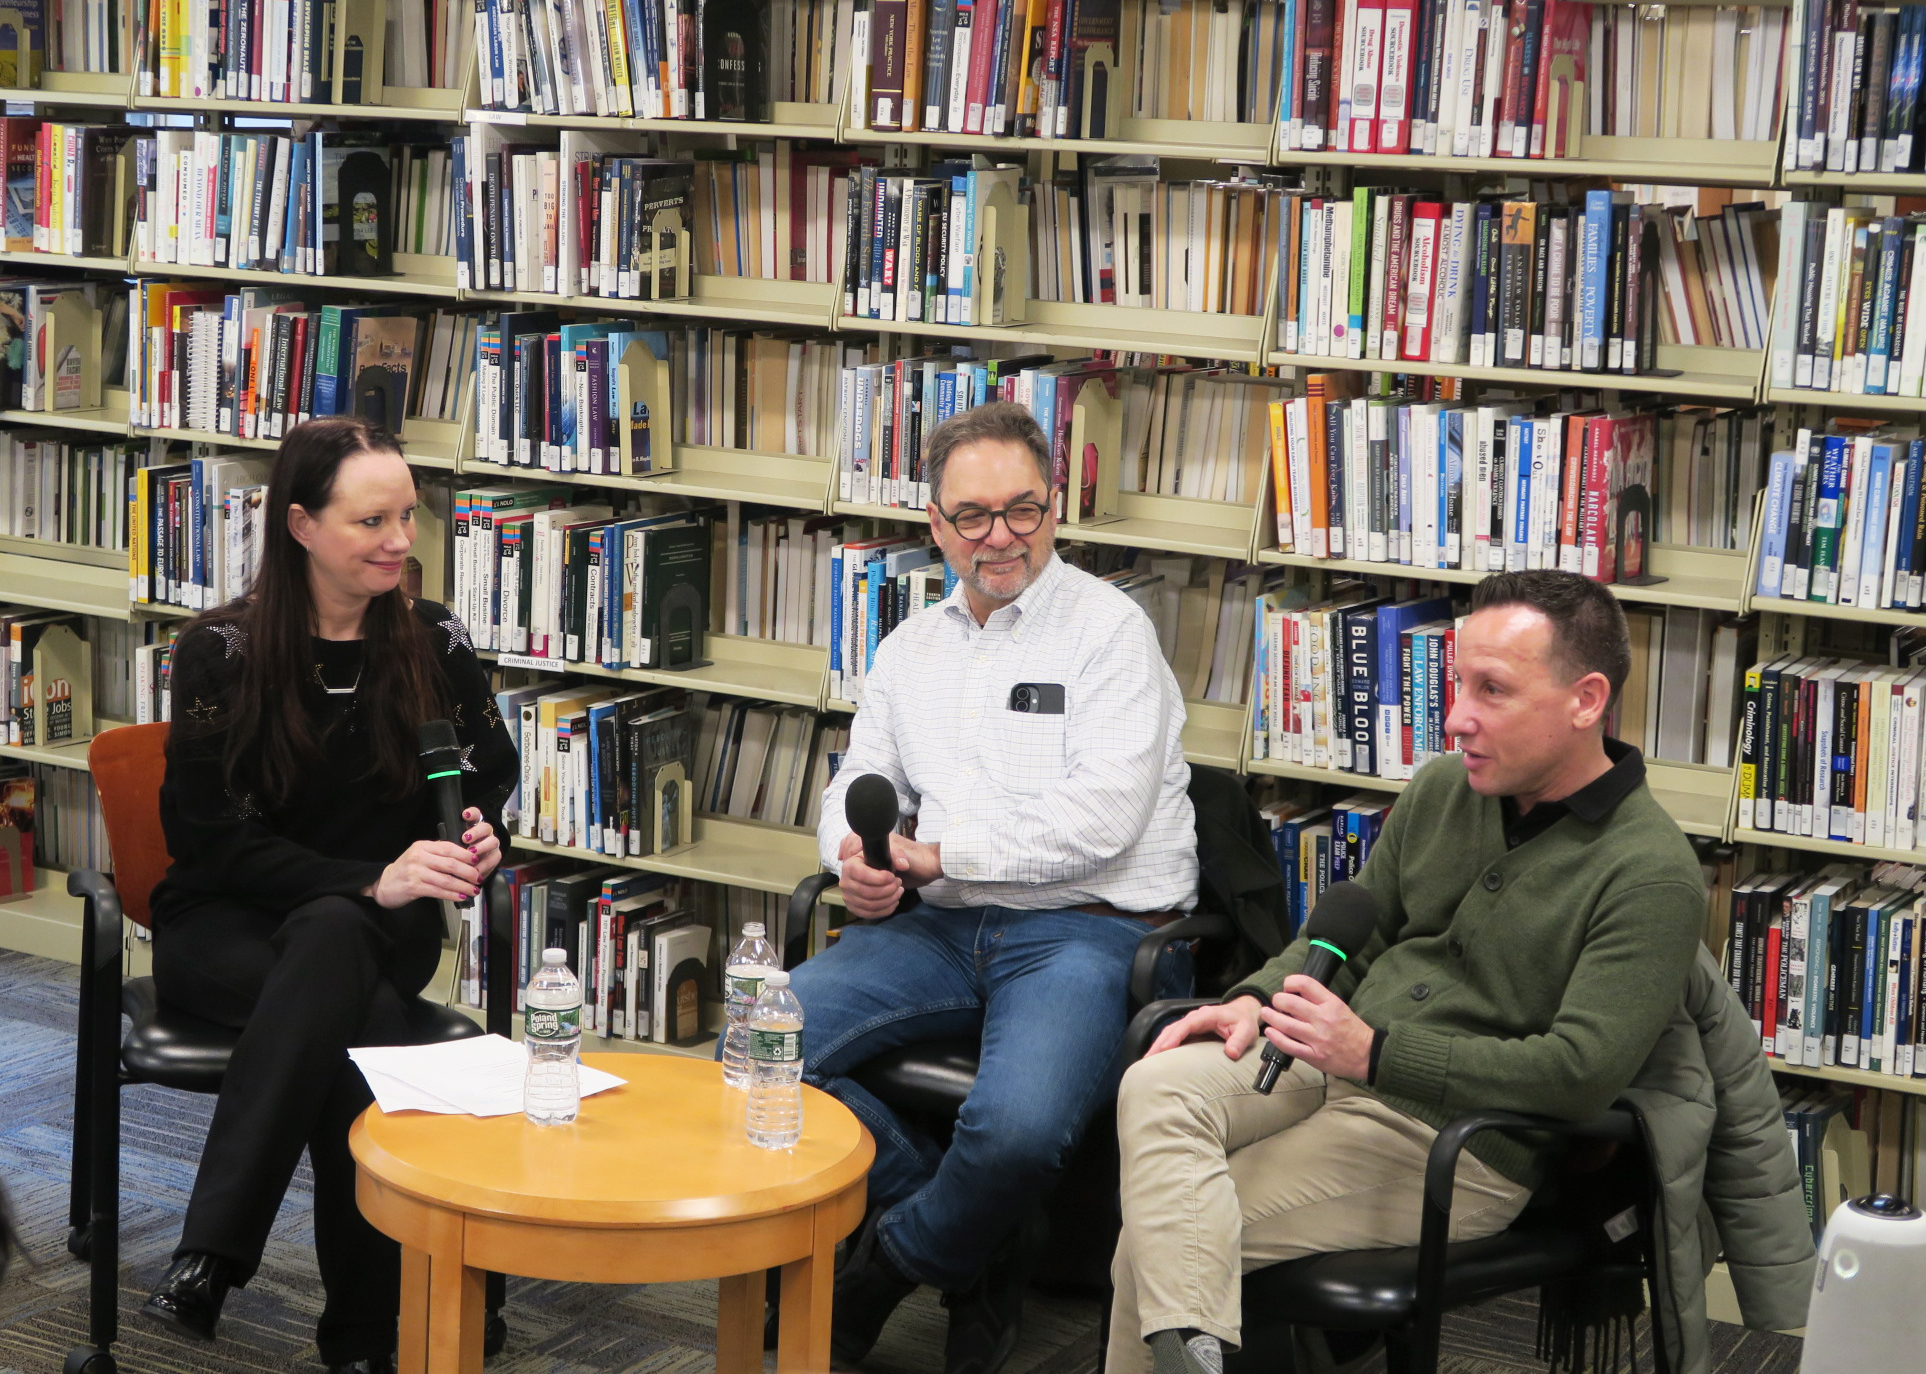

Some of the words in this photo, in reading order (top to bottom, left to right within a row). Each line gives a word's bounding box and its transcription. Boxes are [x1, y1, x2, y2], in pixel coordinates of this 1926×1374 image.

[956, 31, 965, 68] Encyclopedia
[1358, 26, 1368, 72] SOURCEBOOK
[1397, 21, 1406, 52] Domestic
[886, 47, 894, 78] PRACTICE
[1048, 40, 1057, 73] REPORT
[1366, 49, 1374, 69] Abuse
[1387, 27, 1397, 76] SOURCEBOOK
[1462, 48, 1474, 77] DRUG
[1807, 30, 1818, 74] KEEPING
[1307, 52, 1323, 78] Reducing
[1394, 54, 1403, 82] Violence
[952, 72, 961, 103] Everyday
[1307, 79, 1322, 101] Suicide
[1461, 79, 1472, 97] USE
[1806, 76, 1815, 91] US
[488, 113, 502, 121] LAW
[1804, 95, 1814, 122] SAFE
[863, 175, 873, 198] The
[967, 175, 975, 214] Understanding
[643, 197, 684, 212] PERVERTS
[876, 182, 885, 238] UNDAUNTED
[915, 199, 923, 222] WARS
[942, 212, 948, 222] EU
[954, 201, 962, 224] Cyber
[1392, 201, 1404, 224] DRUGS
[861, 200, 873, 241] Fourth
[915, 223, 922, 234] OF
[966, 214, 974, 229] Cyber
[1391, 224, 1402, 239] AND
[1321, 206, 1335, 279] Methamphetamine
[1372, 213, 1386, 264] Smacked
[1391, 239, 1401, 253] THE
[1441, 223, 1451, 255] ALMOST
[1587, 222, 1600, 273] FAMILIES
[861, 245, 872, 271] Star
[884, 250, 894, 285] WAR?
[1411, 237, 1422, 283] SOURCEBOOK
[1419, 235, 1431, 285] Alcoholism
[1884, 249, 1896, 282] CRIMES
[1389, 253, 1400, 290] AMERICAN
[1437, 257, 1448, 300] ALCOHOLIC
[1806, 262, 1817, 282] Public
[1387, 291, 1399, 315] DREAM
[1803, 281, 1815, 307] Housing
[1864, 281, 1872, 300] EYES
[1880, 282, 1893, 316] AGAINST
[1584, 286, 1598, 338] POVERTY
[1803, 307, 1813, 323] That
[1860, 300, 1872, 328] WIDE
[1801, 322, 1812, 345] Worked
[1858, 328, 1868, 349] OPEN
[1877, 317, 1889, 350] NATURE
[277, 338, 289, 391] International
[490, 371, 498, 383] The
[275, 393, 286, 409] Law
[490, 383, 498, 408] Public
[490, 408, 498, 436] Domain
[577, 399, 585, 436] Bankruptcy
[854, 376, 865, 450] UNDERDOGS
[1329, 413, 1337, 427] All
[1329, 428, 1337, 444] You
[1329, 445, 1337, 461] Can
[1479, 440, 1487, 466] abused
[1911, 446, 1919, 459] AIR
[1329, 463, 1337, 482] Ever
[1771, 461, 1783, 498] CLIMATE
[1821, 449, 1833, 485] MAKERS
[1827, 447, 1840, 489] WEATHER
[1907, 459, 1918, 497] POLLUTION
[1328, 484, 1336, 506] Know
[1566, 456, 1578, 509] CROWDSOURCING
[1565, 510, 1574, 522] THE
[1584, 490, 1600, 547] NARCOLAND
[1767, 498, 1780, 535] CHANGE
[1564, 523, 1574, 537] LAW
[589, 568, 598, 610] Contracts
[502, 589, 510, 623] Divorce
[1351, 625, 1369, 678] BLUE
[1403, 648, 1412, 674] FIGHT
[1428, 637, 1440, 659] JOHN
[1446, 640, 1454, 664] PULLED
[503, 657, 534, 666] CRIMINAL
[535, 660, 559, 668] JUSTICE
[1282, 650, 1290, 680] DEFUND
[1282, 682, 1291, 702] FEAR
[1403, 675, 1412, 692] THE
[1428, 661, 1441, 708] DOUGLAS'S
[52, 701, 72, 715] Jobs
[1402, 694, 1412, 724] POWER
[1840, 691, 1848, 709] Crime
[1353, 691, 1371, 742] BLOO
[1742, 700, 1758, 756] Criminology
[1839, 718, 1847, 734] Social
[1819, 730, 1830, 758] Snapshots
[1838, 733, 1847, 754] Control
[523, 731, 531, 785] Sarbanes-Oxley
[1817, 765, 1828, 792] Research
[1333, 840, 1341, 856] EXAM
[1333, 856, 1341, 871] PREP
[617, 915, 625, 934] When
[617, 935, 625, 950] Law
[616, 950, 625, 968] Fails
[1778, 953, 1789, 1000] POLICEMAN
[1811, 974, 1819, 1003] DOMESTIC
[1829, 964, 1837, 991] GENDERED
[1890, 981, 1898, 996] When
[530, 1012, 558, 1023] Poland
[1809, 1003, 1818, 1029] VIOLENCE
[1889, 996, 1897, 1018] Children
[531, 1020, 559, 1033] Spring
[1888, 1017, 1896, 1026] Kill
